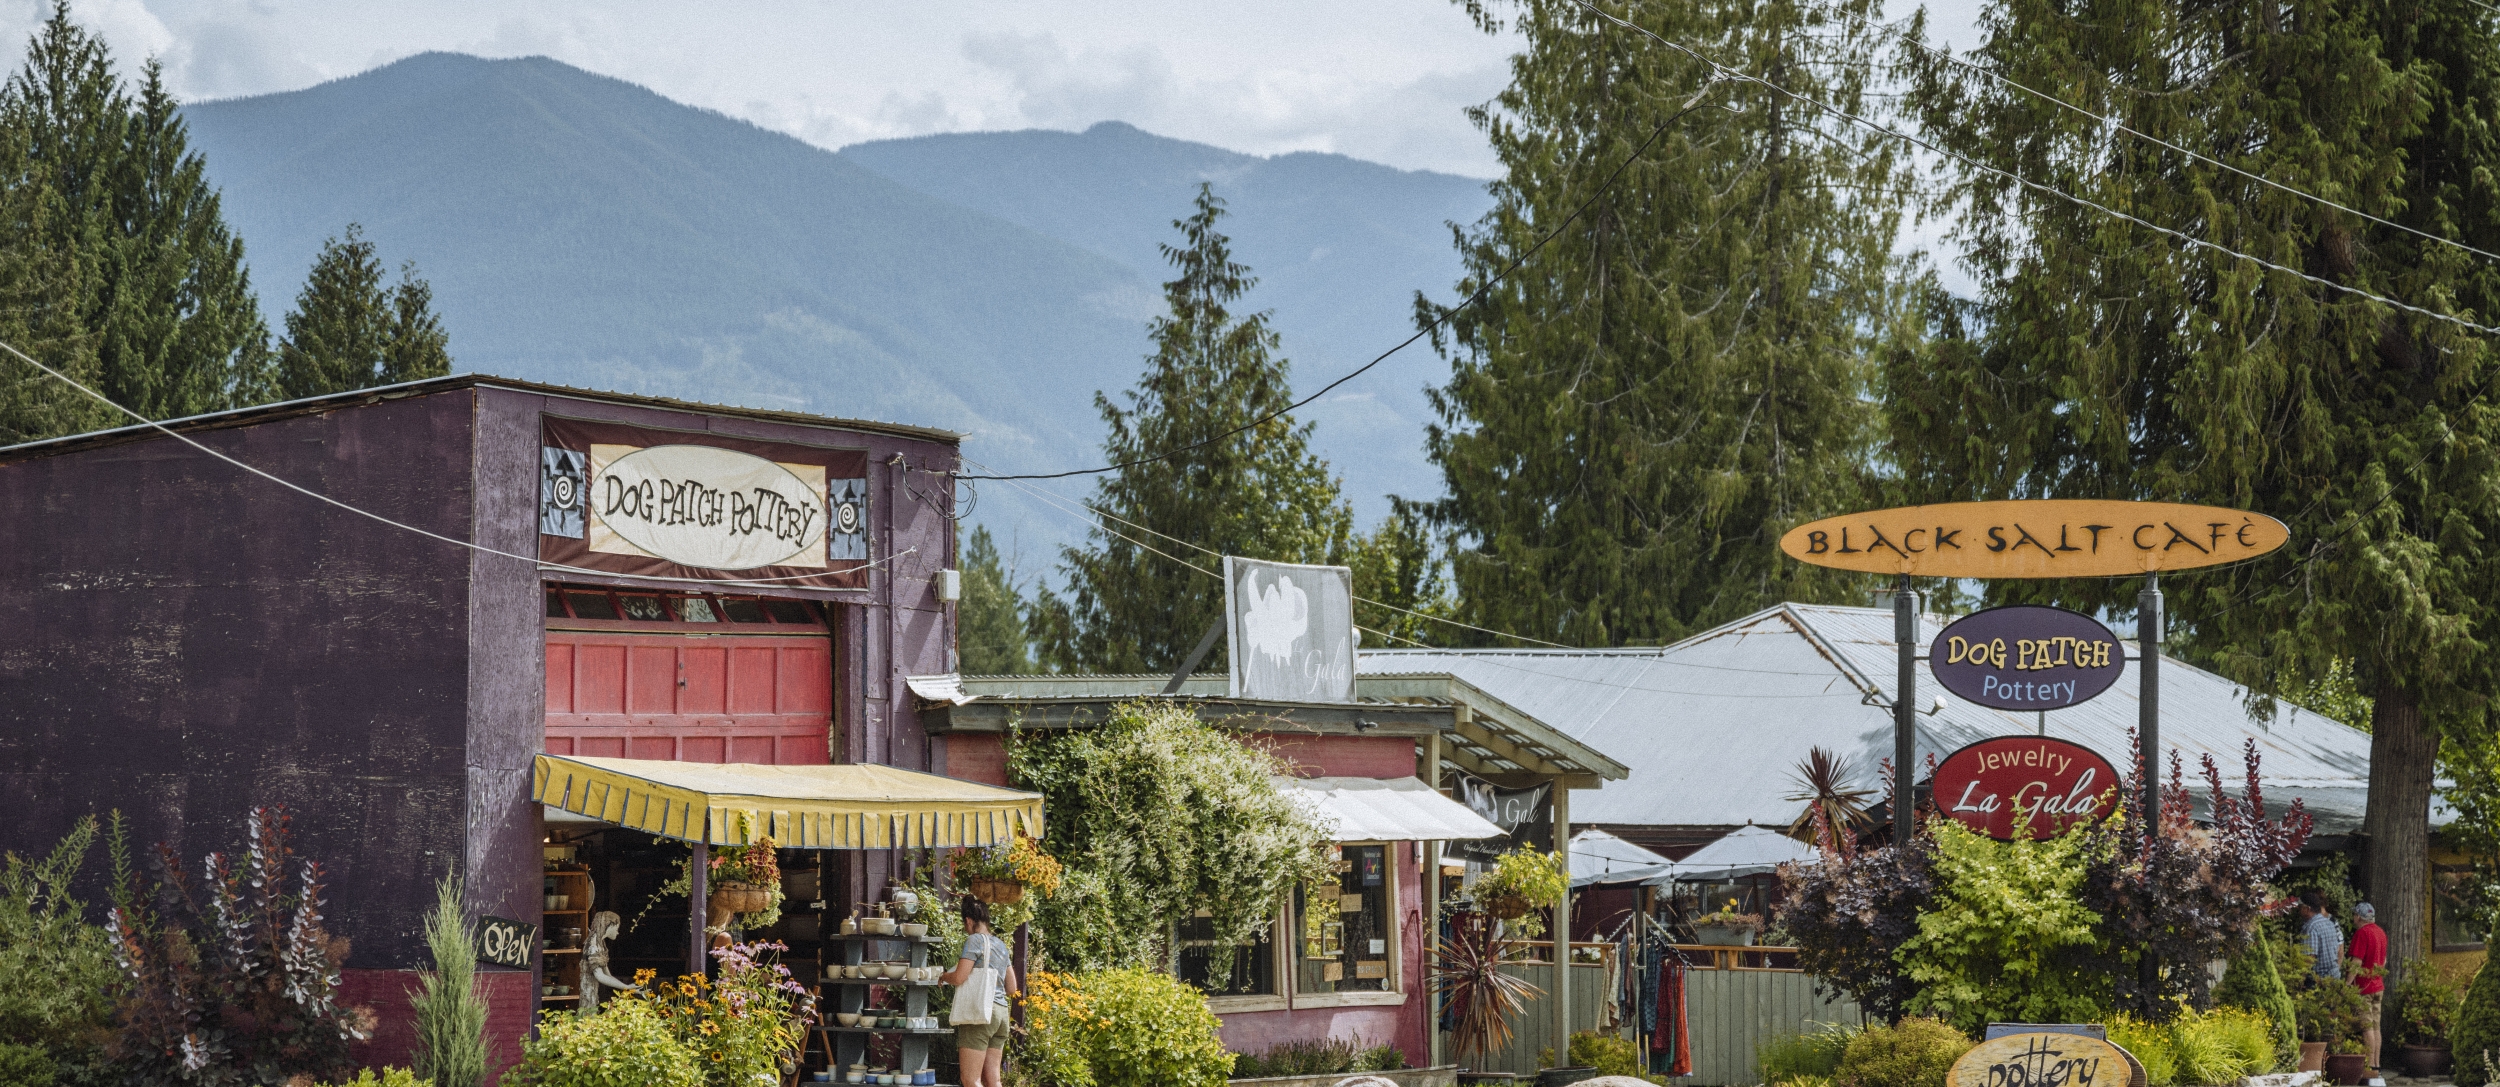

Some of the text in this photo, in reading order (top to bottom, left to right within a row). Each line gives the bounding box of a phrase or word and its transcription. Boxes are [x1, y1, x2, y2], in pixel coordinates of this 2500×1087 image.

[605, 474, 817, 548] DOG PATCH POTTERY
[1805, 524, 1961, 559] BLACK
[1985, 522, 2113, 559] SALT
[1304, 636, 1347, 695] Gala
[1946, 634, 2112, 671] DOG PATCH
[1983, 675, 2076, 703] Pottery
[1977, 745, 2073, 776] Jewelry
[1952, 767, 2099, 828] La Gala
[1365, 858, 1381, 874] Art
[1979, 1035, 2100, 1087] pottery
